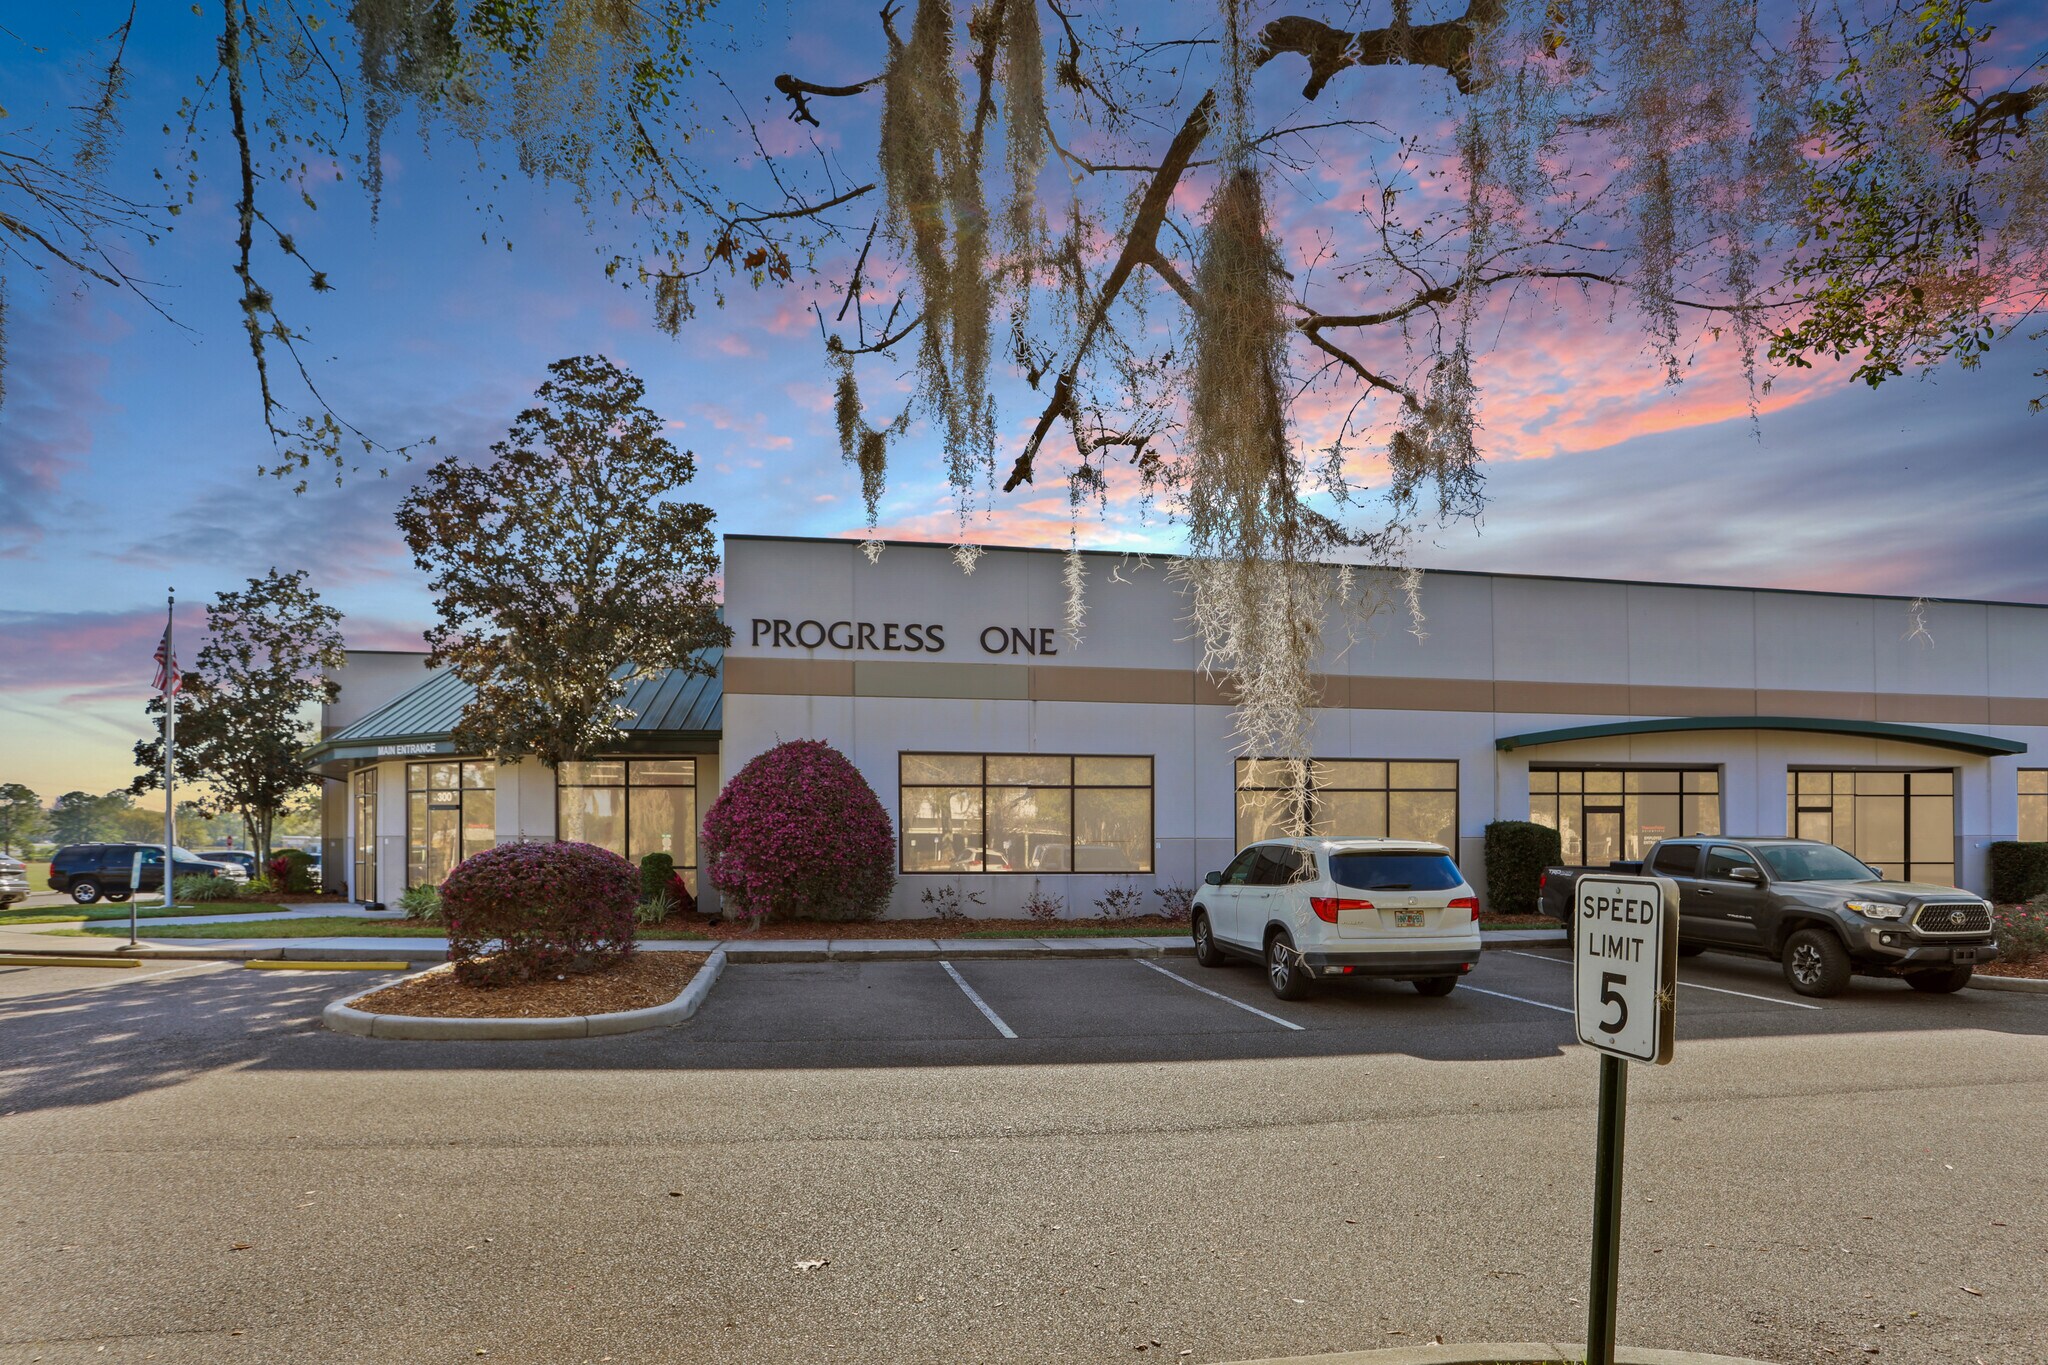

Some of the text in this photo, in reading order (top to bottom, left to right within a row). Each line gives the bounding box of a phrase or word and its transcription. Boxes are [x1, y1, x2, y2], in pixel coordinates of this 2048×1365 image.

[752, 619, 1057, 656] PROGRESS ONE
[378, 743, 436, 756] MAIN ENTRANCE
[437, 792, 452, 802] 300
[1583, 896, 1654, 925] SPEED
[1589, 933, 1644, 962] LIMIT
[1598, 971, 1628, 1034] 5
